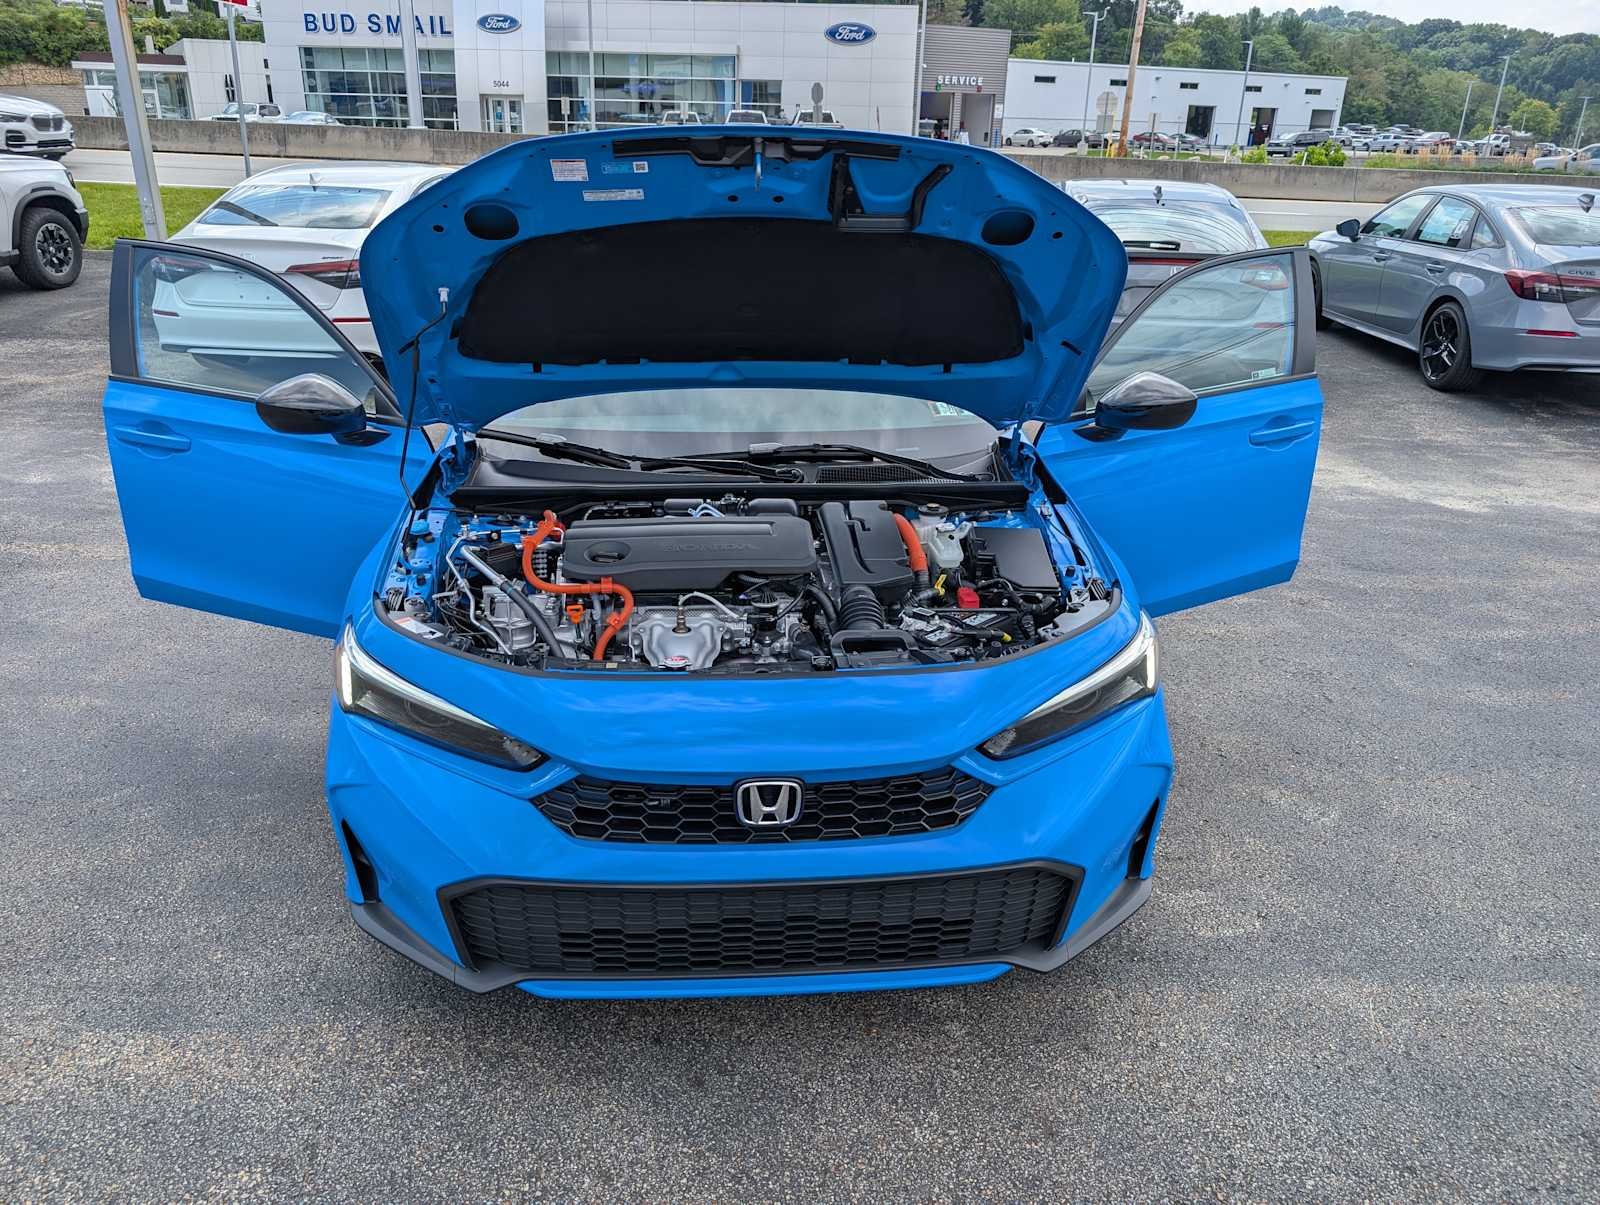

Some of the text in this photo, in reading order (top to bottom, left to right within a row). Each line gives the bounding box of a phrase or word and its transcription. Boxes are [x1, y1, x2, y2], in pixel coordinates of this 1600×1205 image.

[303, 13, 453, 35] BUD SMAIL
[485, 16, 511, 29] Ford
[835, 25, 865, 41] Ford
[493, 80, 510, 88] 5044
[937, 75, 984, 86] SERVICE
